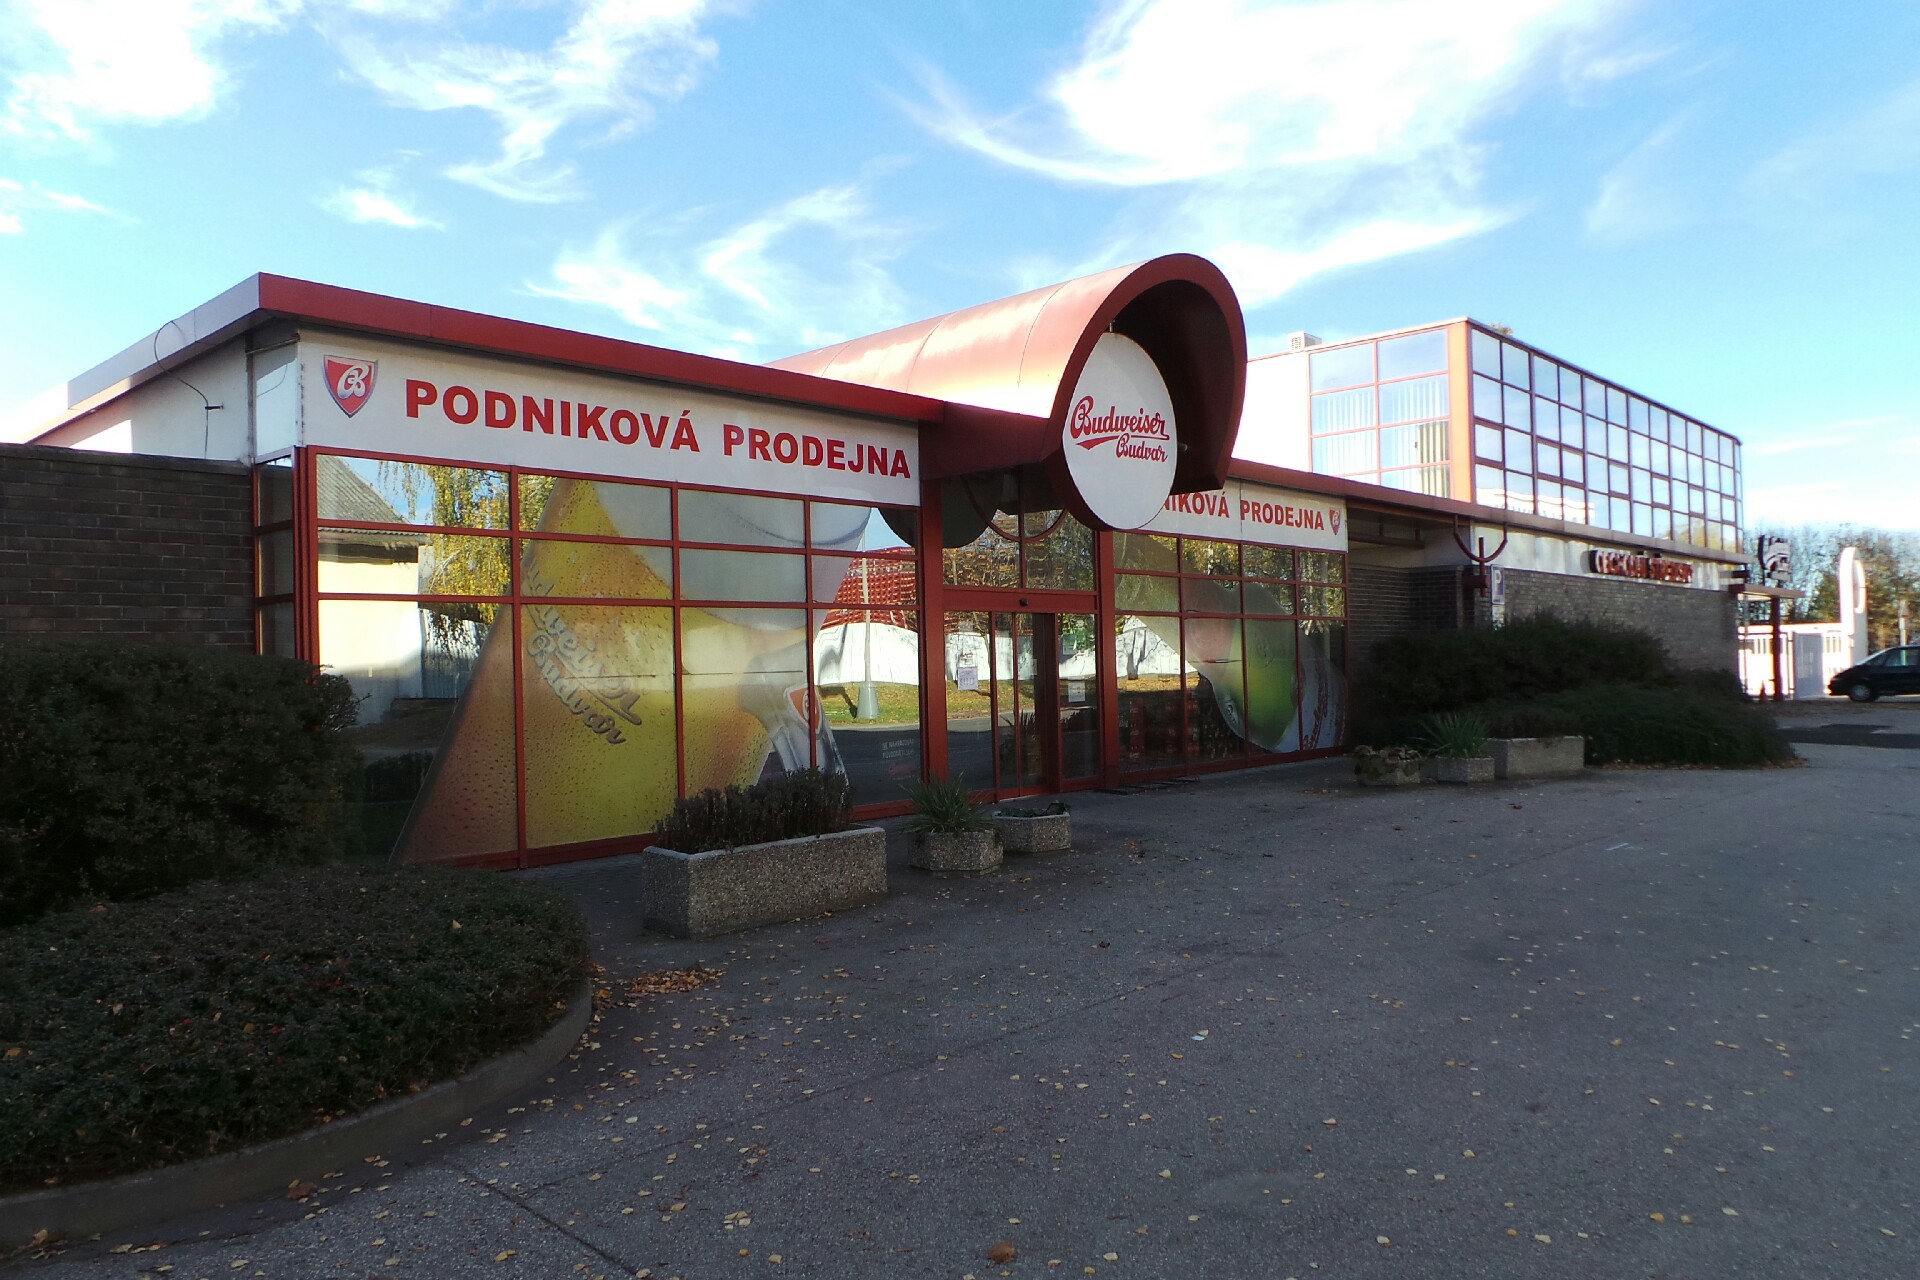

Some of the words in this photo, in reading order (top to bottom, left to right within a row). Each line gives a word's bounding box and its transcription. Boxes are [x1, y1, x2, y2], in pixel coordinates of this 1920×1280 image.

[405, 379, 700, 453] PODNIKOVÁ
[723, 423, 911, 479] PRODEJNA
[1070, 395, 1169, 440] Budweiser
[1115, 433, 1168, 462] Budvar
[1240, 500, 1324, 531] PRODEJNA
[527, 629, 626, 744] Budvar
